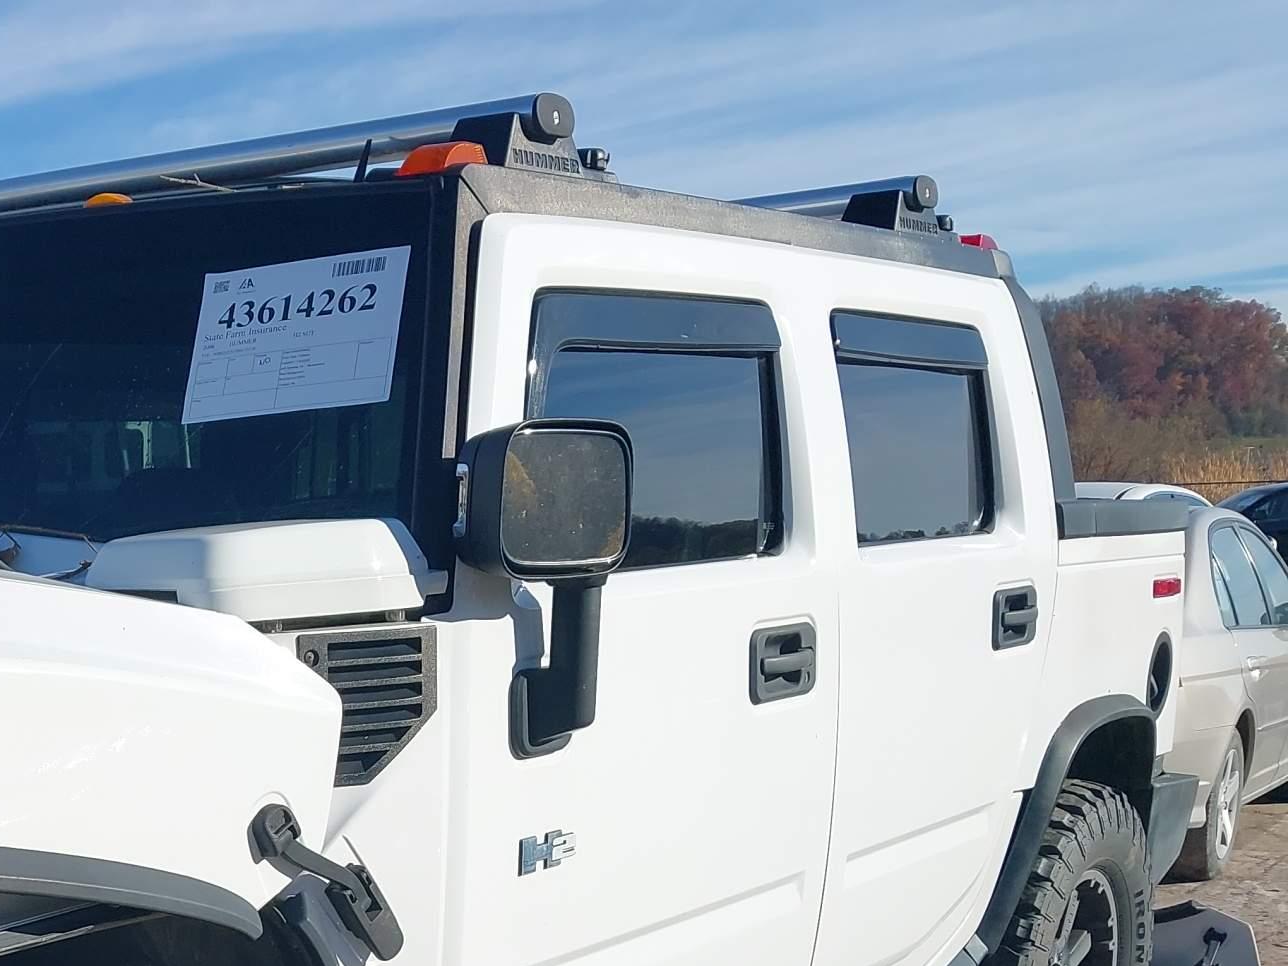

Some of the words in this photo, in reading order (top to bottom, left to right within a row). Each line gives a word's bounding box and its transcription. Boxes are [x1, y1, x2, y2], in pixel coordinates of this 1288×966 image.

[512, 148, 580, 174] HUMMER
[899, 216, 938, 235] HUMMER
[218, 283, 377, 329] 43614262
[226, 329, 246, 340] Farm
[248, 325, 287, 336] Insurance
[518, 829, 576, 877] H2
